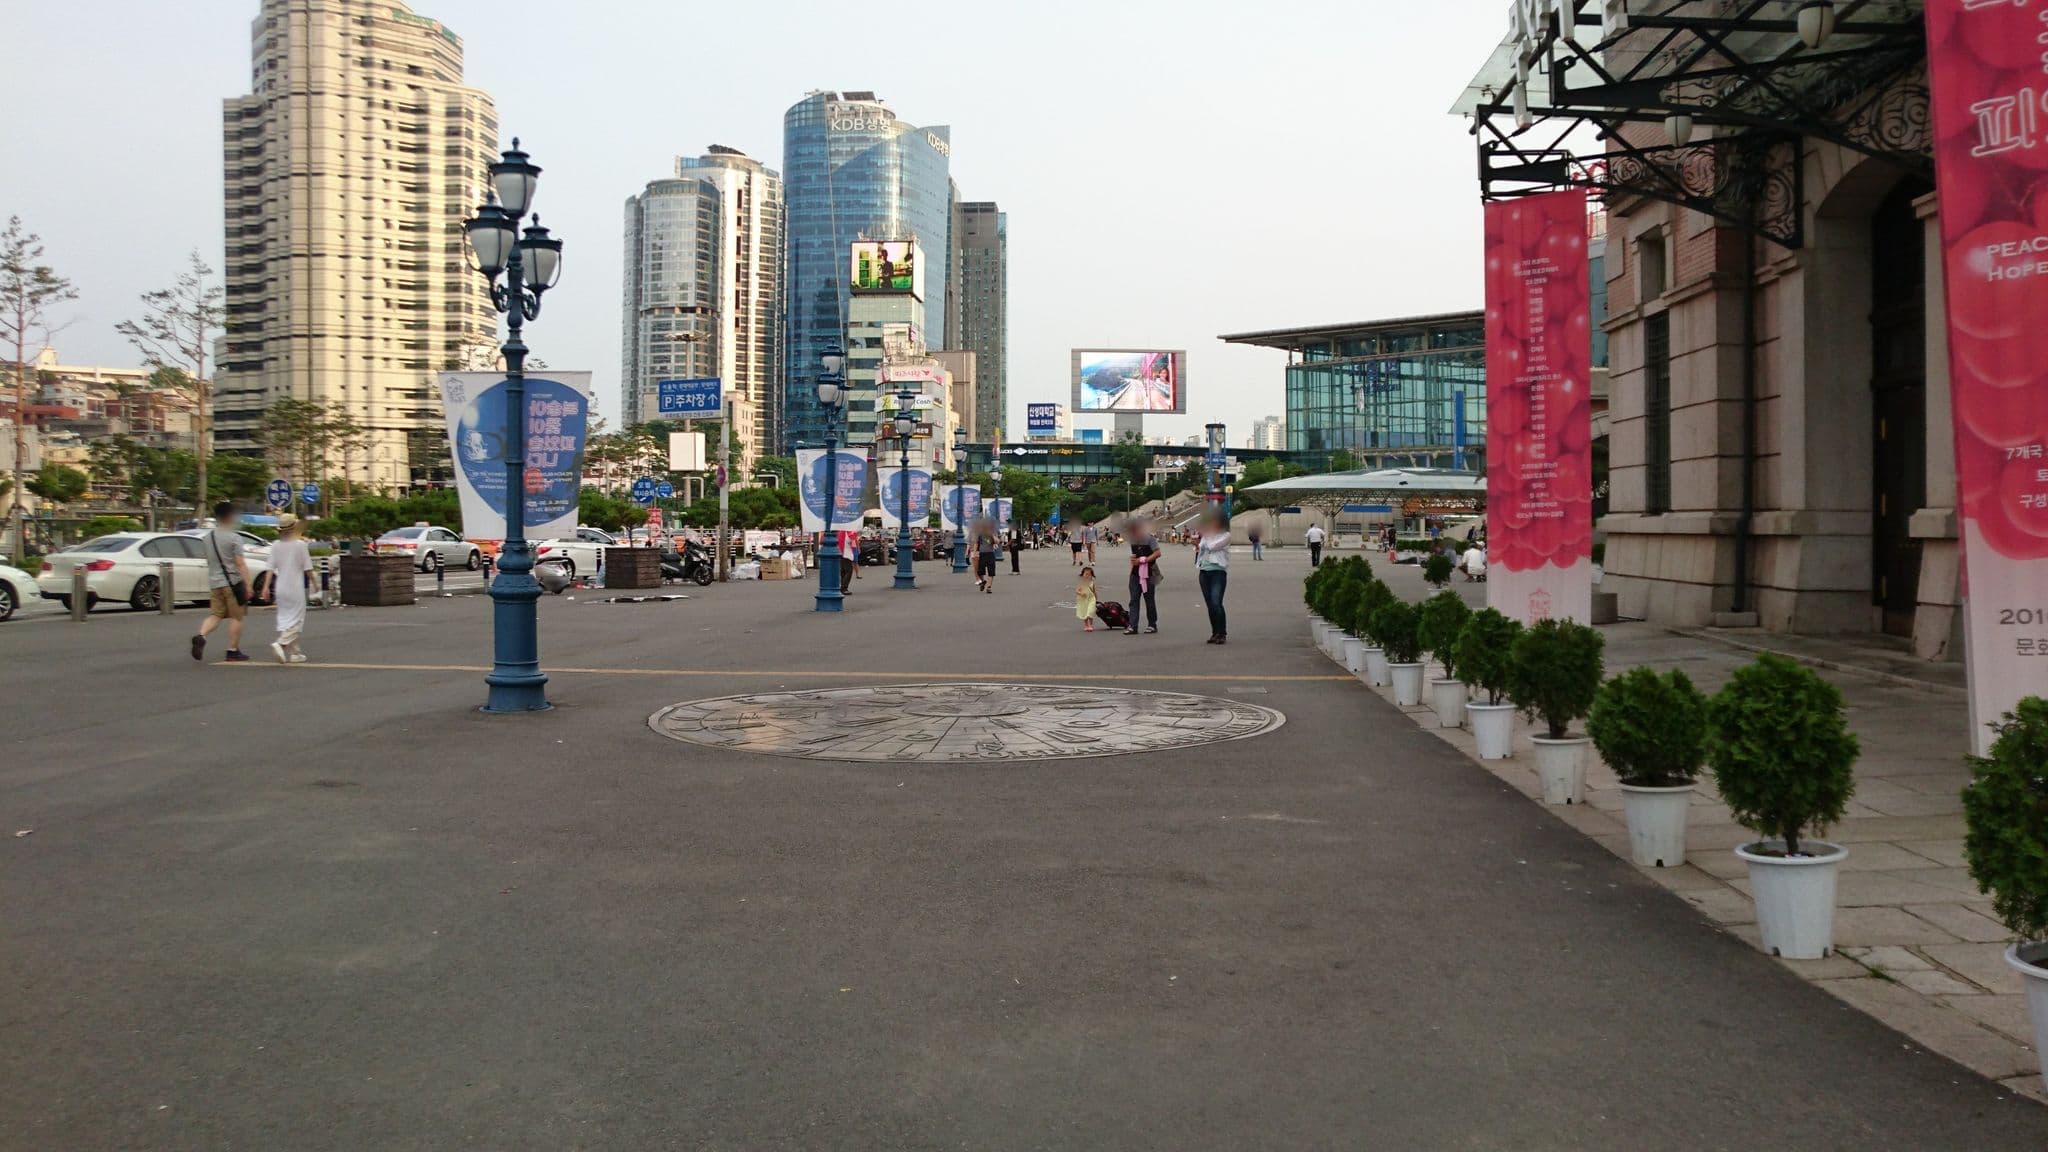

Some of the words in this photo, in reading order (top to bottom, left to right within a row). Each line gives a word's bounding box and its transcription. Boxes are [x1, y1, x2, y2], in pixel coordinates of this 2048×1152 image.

[831, 118, 891, 131] KDB생명
[664, 396, 672, 408] P
[675, 393, 706, 408] 주차장
[2006, 444, 2043, 460] 7개국
[2000, 608, 2048, 625] 201
